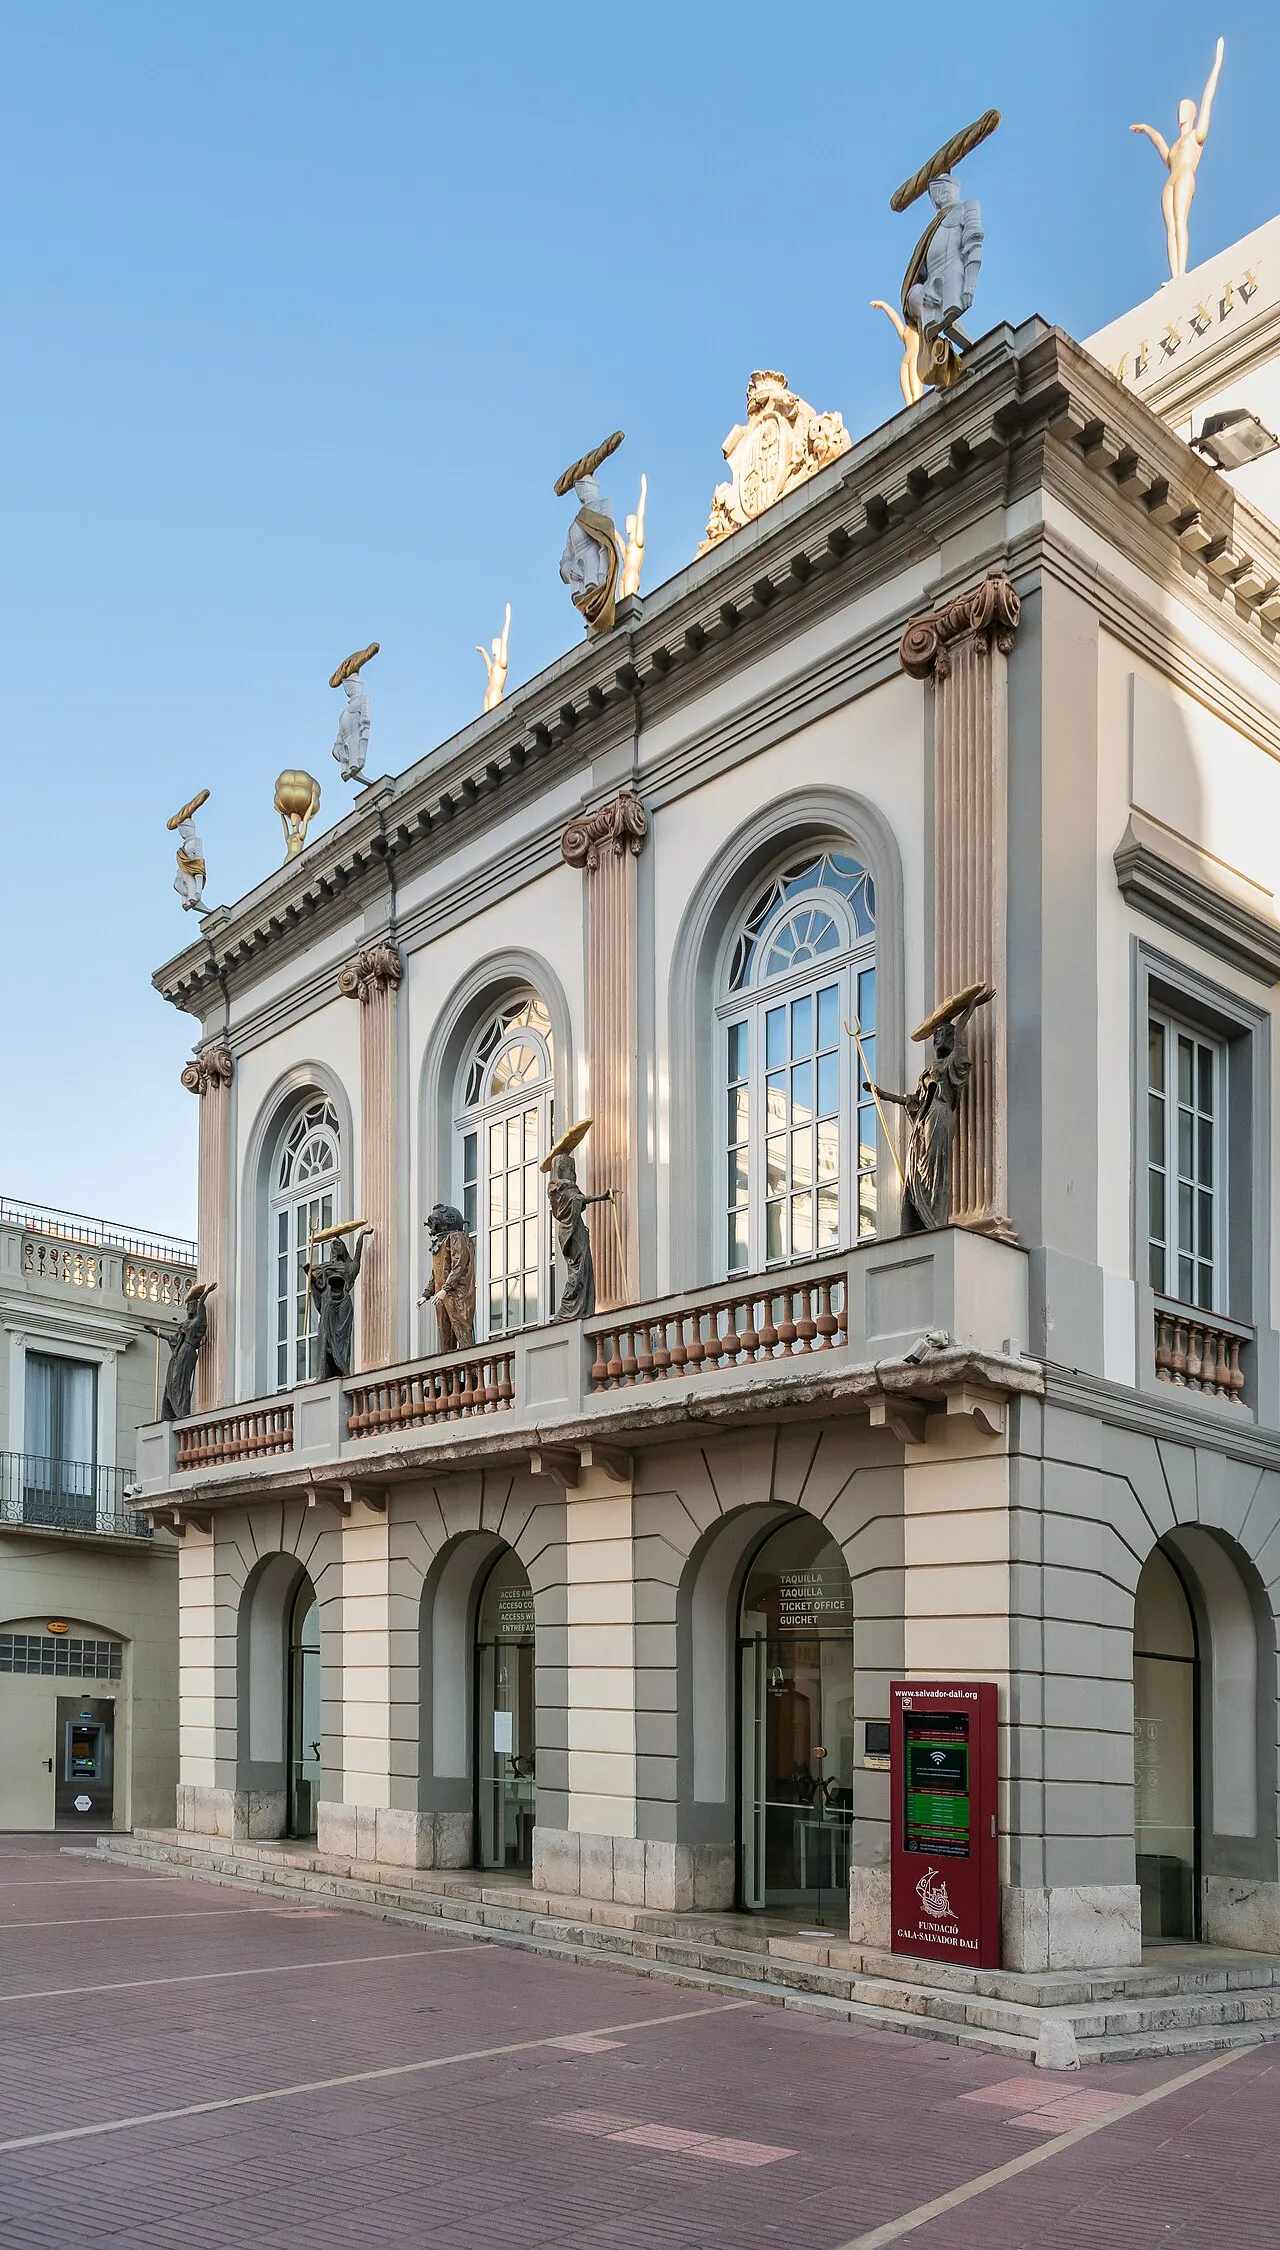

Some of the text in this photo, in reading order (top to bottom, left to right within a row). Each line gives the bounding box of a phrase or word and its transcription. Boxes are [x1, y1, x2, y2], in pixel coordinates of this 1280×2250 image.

[780, 1574, 823, 1584] TAQUILLA
[780, 1588, 823, 1598] TAQUILLA
[780, 1601, 845, 1611] TICKET OFFICE
[780, 1616, 818, 1624] GUICHET
[895, 1689, 978, 1700] www.salvador-dali.org
[918, 1921, 959, 1934] FUNDACIÓ
[897, 1929, 979, 1949] GALA-SALVADOR DALÍ
